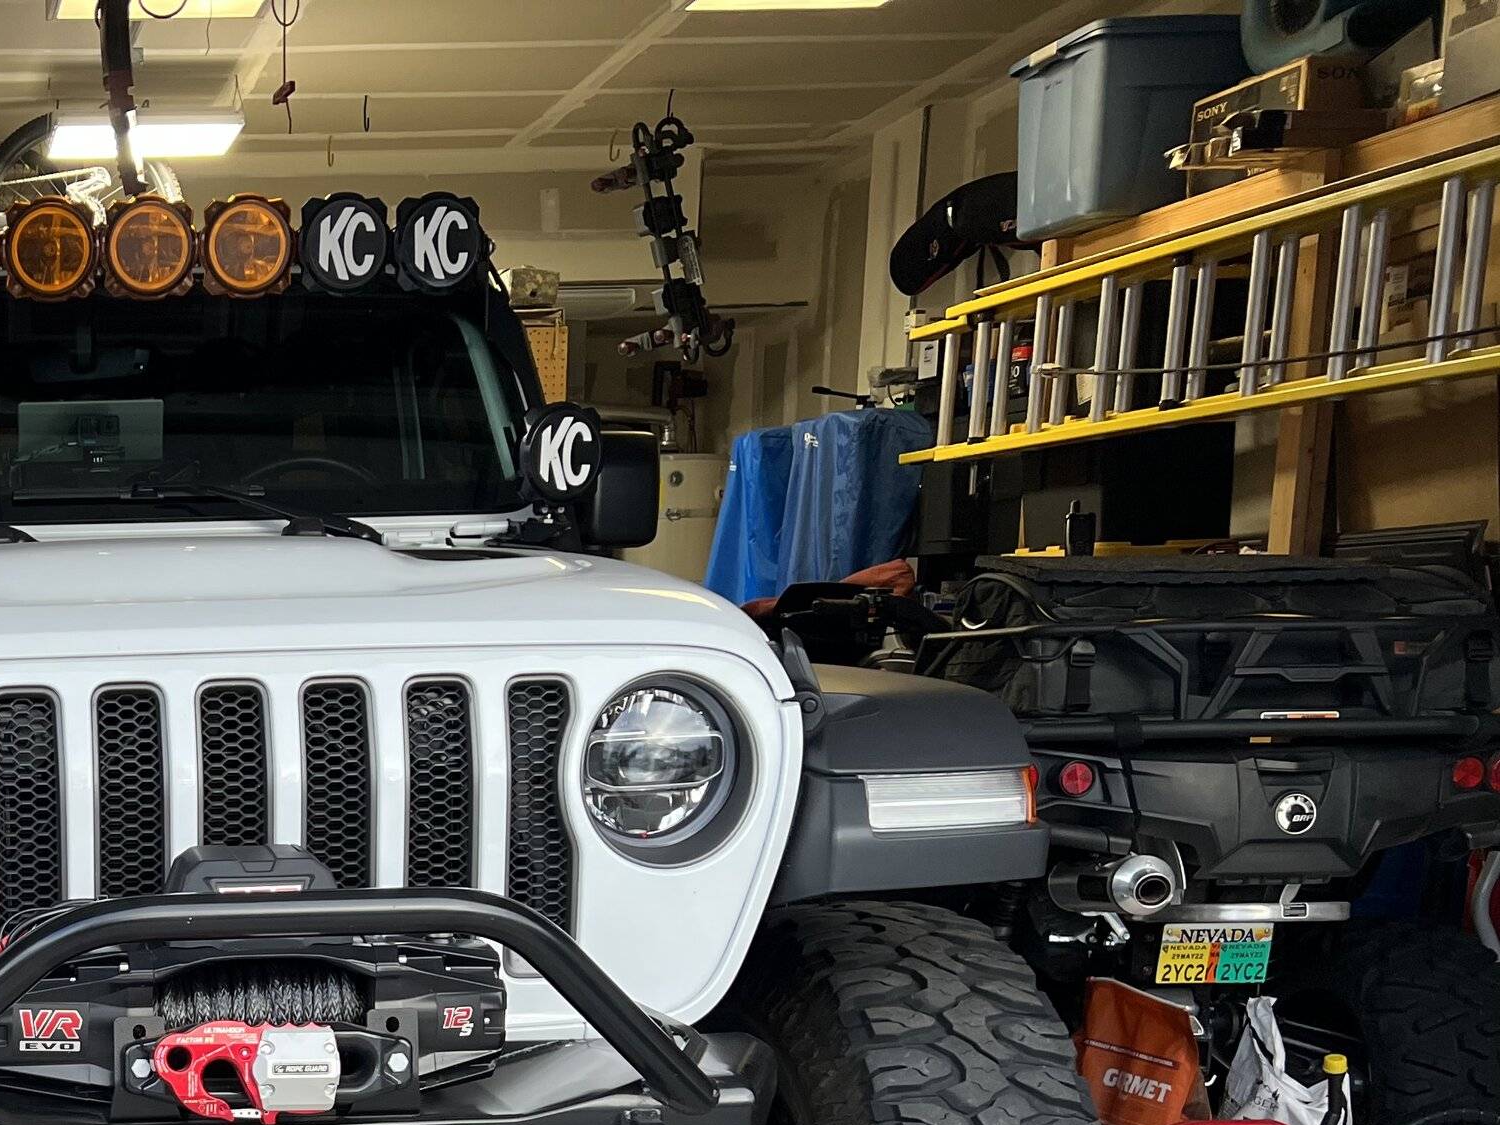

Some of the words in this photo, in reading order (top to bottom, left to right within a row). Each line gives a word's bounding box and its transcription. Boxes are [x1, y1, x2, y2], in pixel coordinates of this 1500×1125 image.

[1197, 101, 1228, 121] SONY
[318, 206, 376, 281] KC
[414, 206, 469, 280] KC
[540, 416, 592, 491] KC
[1291, 814, 1314, 822] BRP
[1180, 929, 1256, 943] NEVADA
[1161, 963, 1206, 982] 2YC2
[1220, 963, 1265, 981] 2YC2
[19, 1009, 83, 1039] VR
[442, 1006, 474, 1029] 12
[25, 1042, 75, 1050] EVO
[285, 1065, 304, 1073] ROPE
[305, 1064, 328, 1072] GUARD
